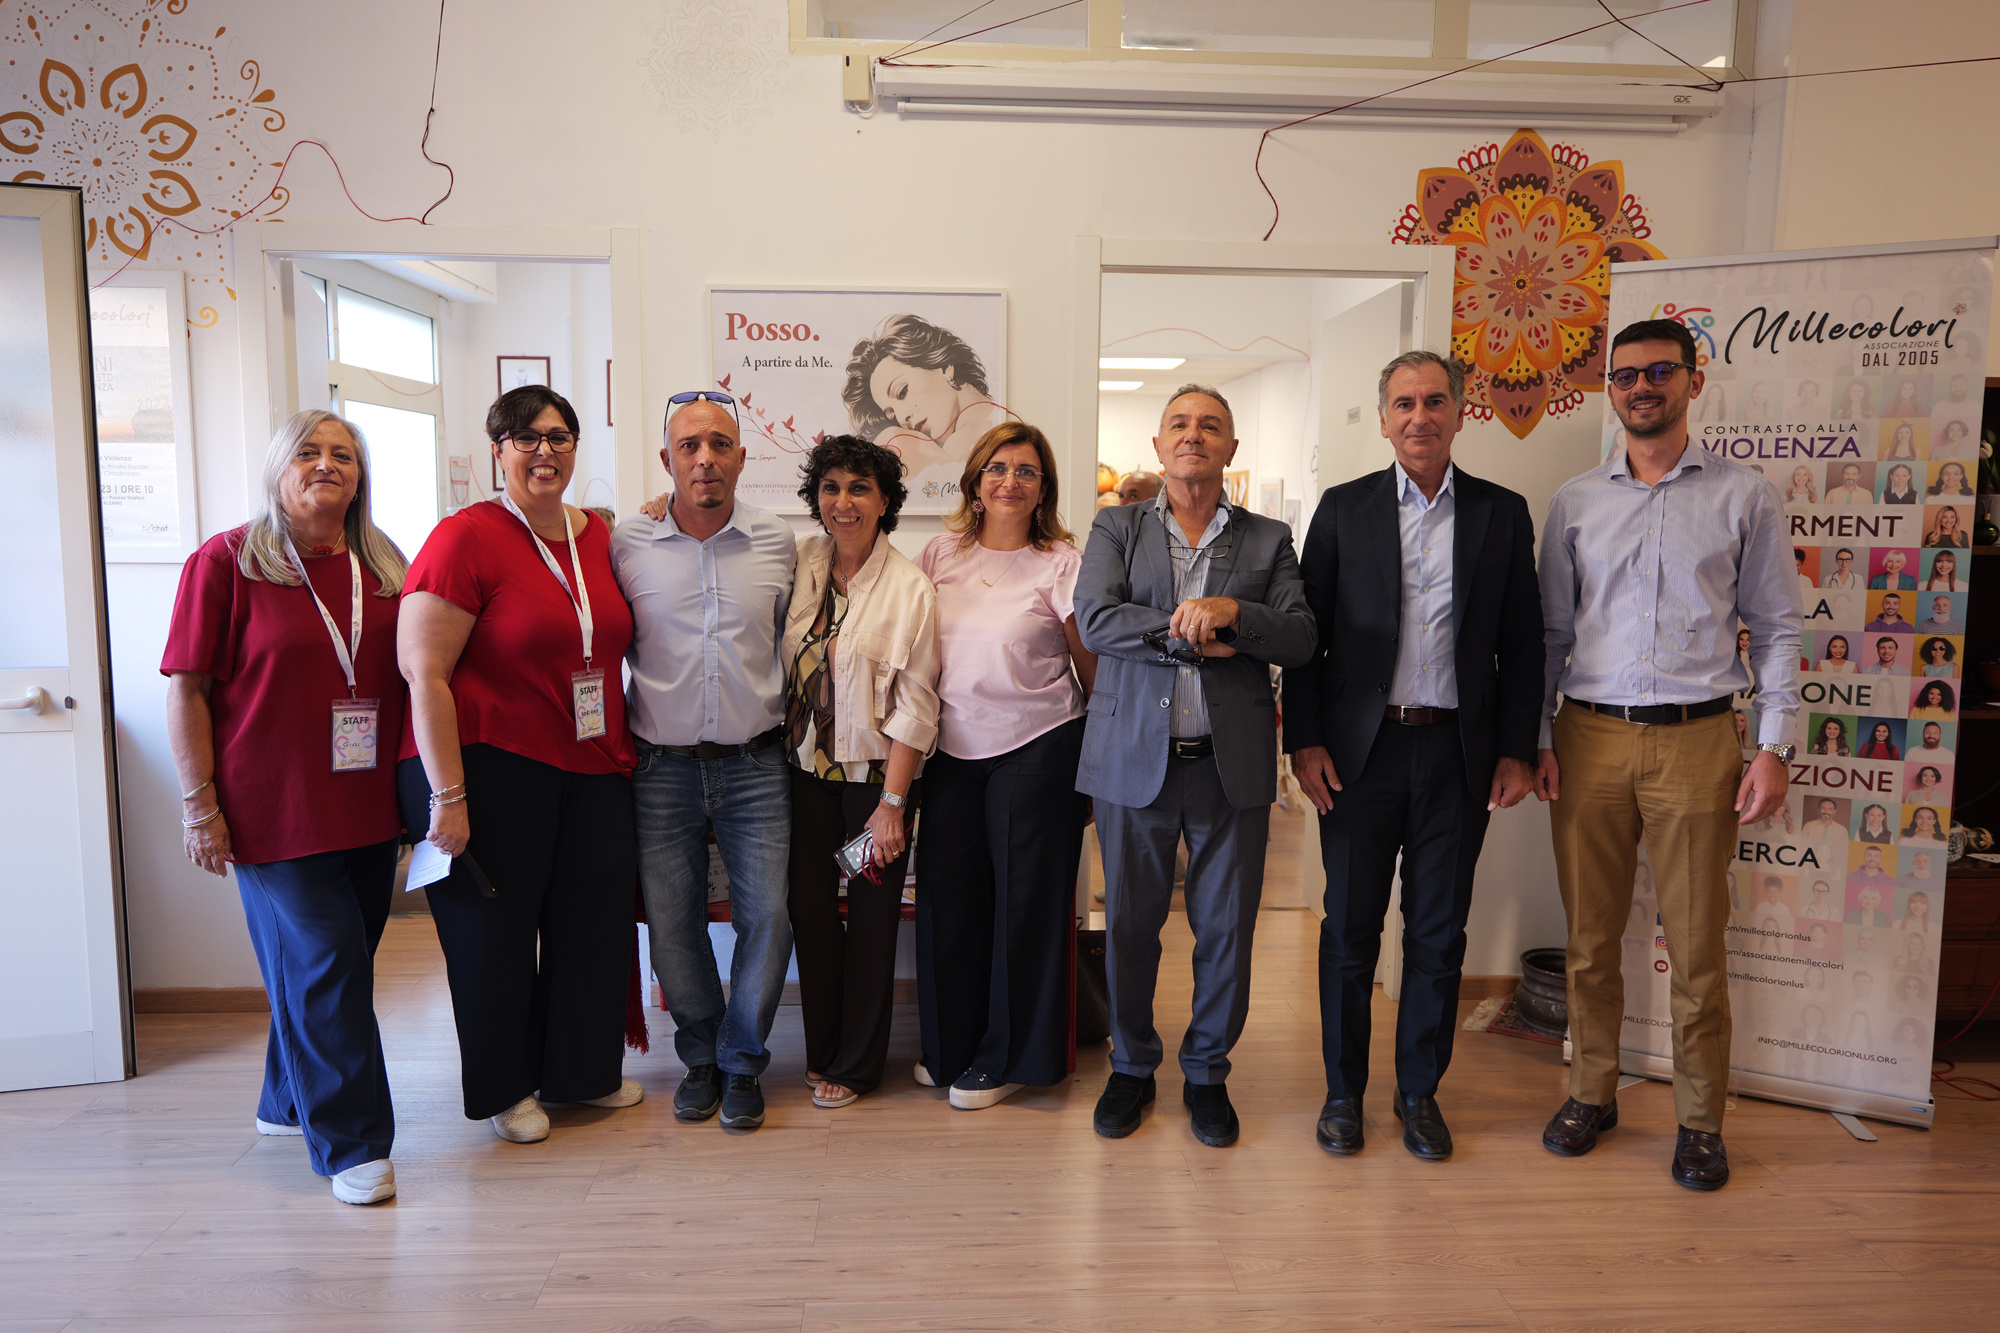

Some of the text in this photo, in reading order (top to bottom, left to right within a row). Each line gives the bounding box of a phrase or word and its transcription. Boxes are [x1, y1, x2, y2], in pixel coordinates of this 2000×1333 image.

[725, 312, 820, 342] Posso.
[1724, 306, 1957, 364] Millecolori
[1863, 340, 1940, 350] ASSOCIAZIONE
[742, 355, 833, 371] A partire da Me.
[1862, 350, 1939, 367] DAL 2005
[1703, 423, 1858, 435] CONTRASTO ALLA
[1701, 436, 1861, 459] VIOLENZA
[120, 484, 142, 493] ORE
[144, 485, 154, 494] 10
[1786, 515, 1904, 537] RMENT
[579, 685, 598, 696] STAFF
[342, 716, 370, 725] STAFF
[1732, 840, 1821, 870] ERCA
[1757, 1036, 1898, 1065] INFO@MILLECOLORIONLUS.ORG
